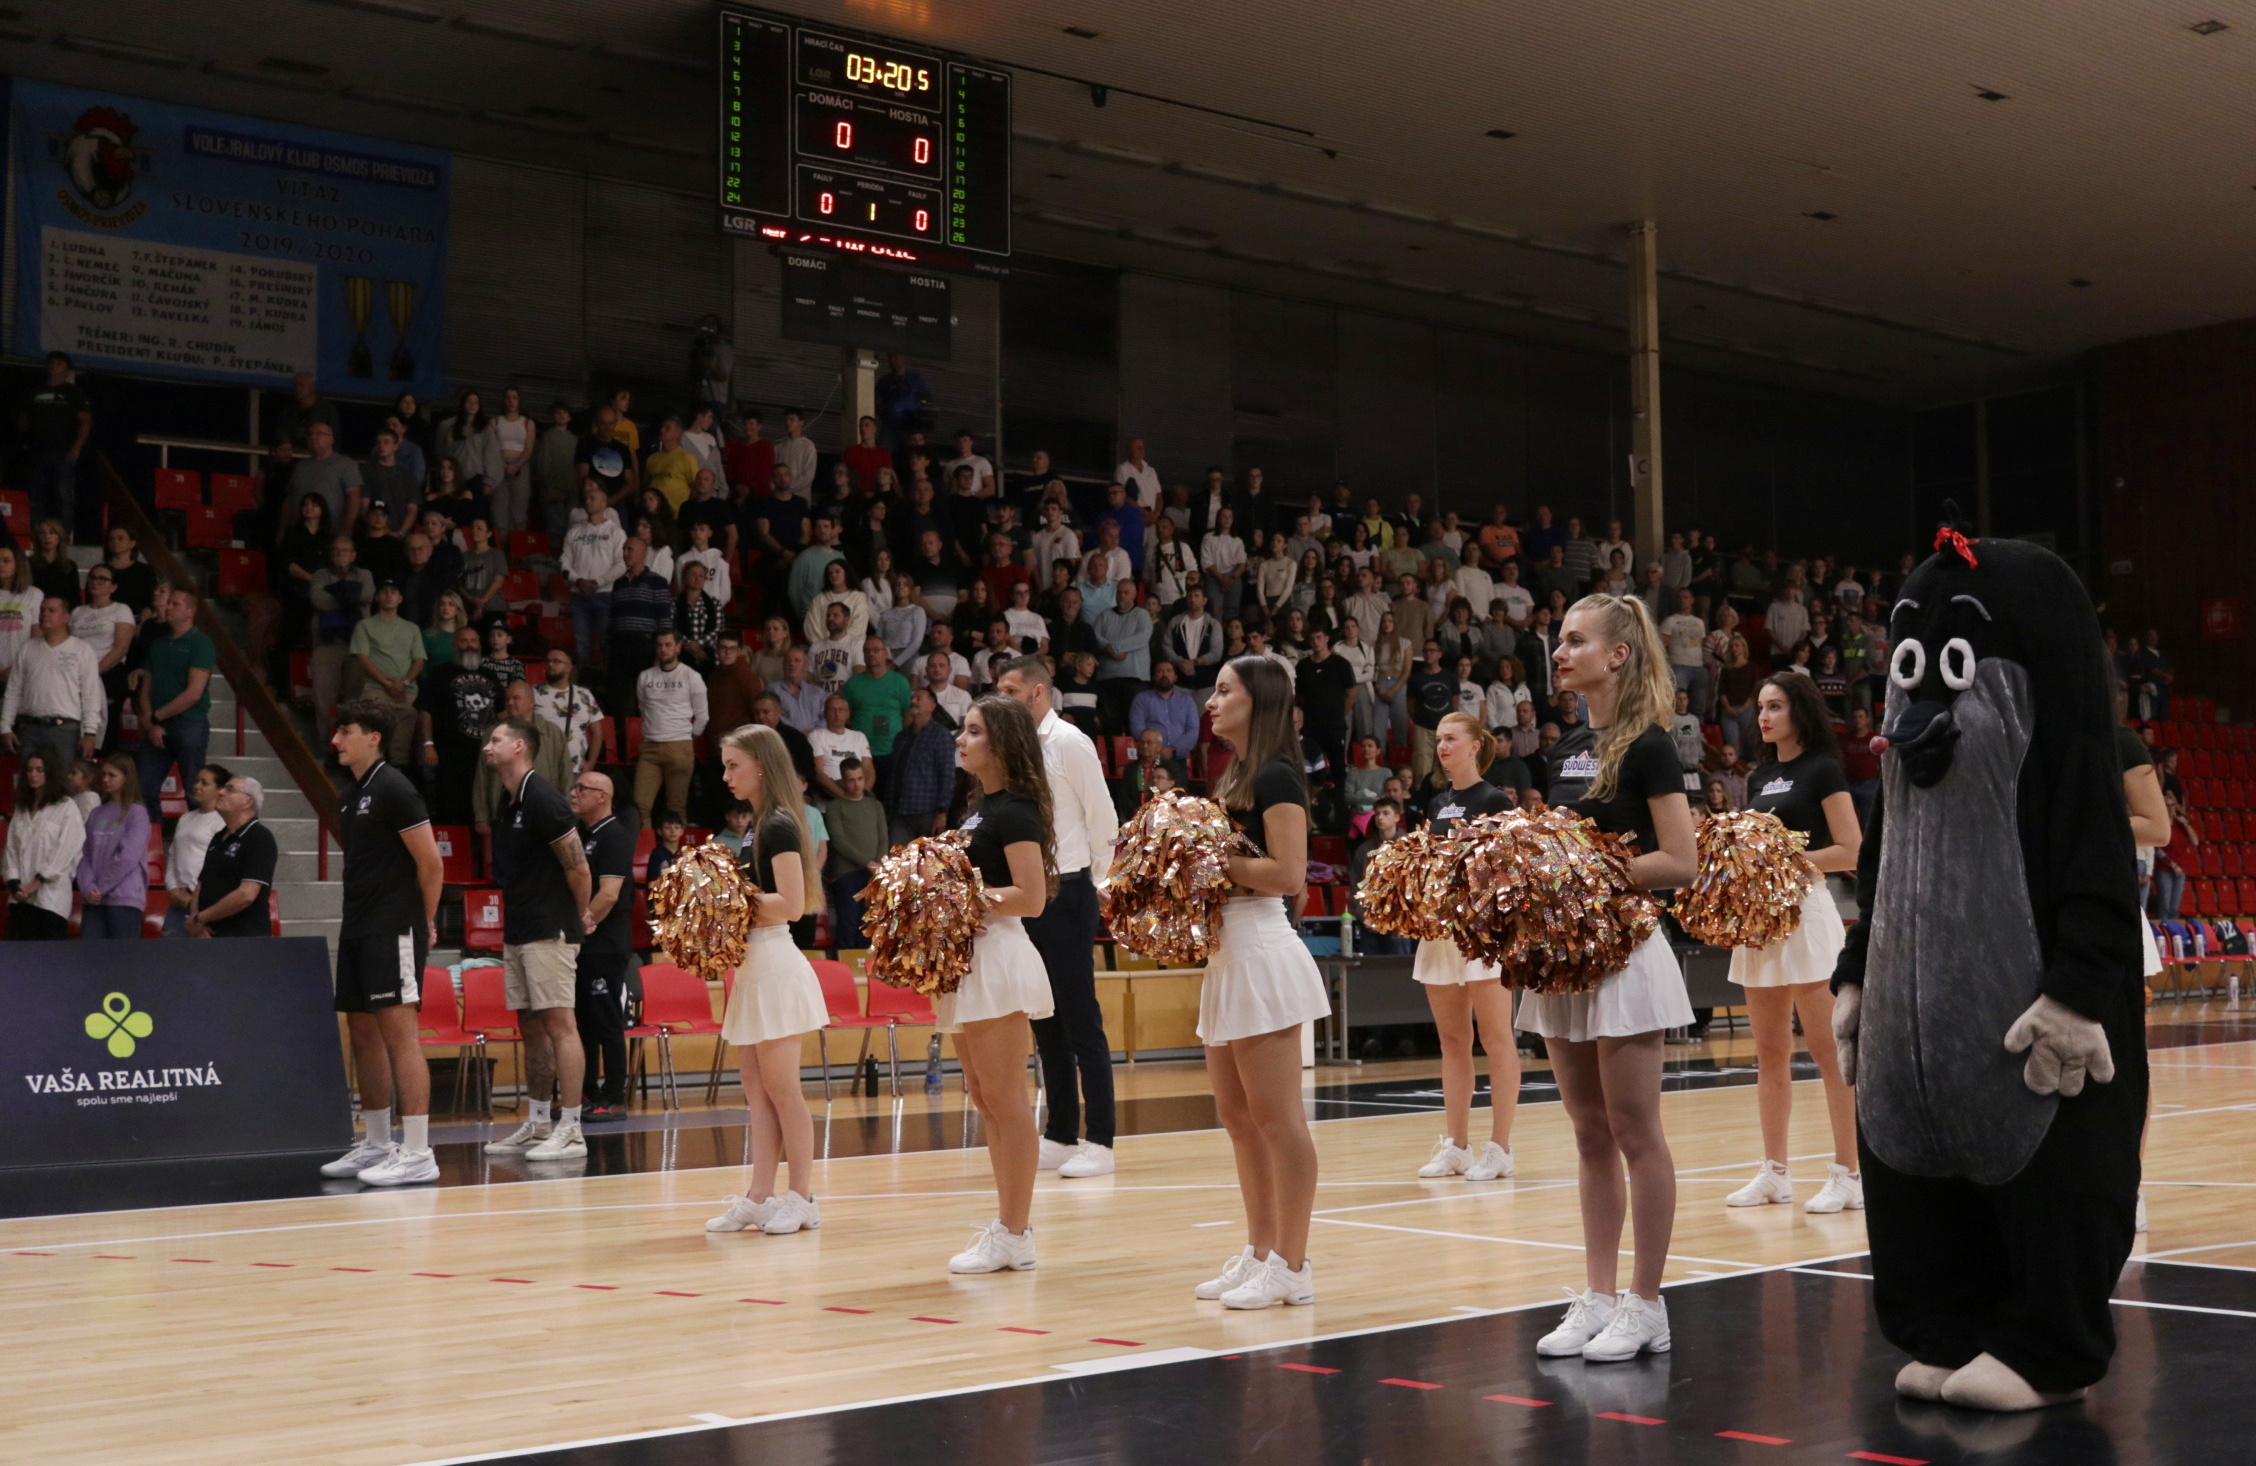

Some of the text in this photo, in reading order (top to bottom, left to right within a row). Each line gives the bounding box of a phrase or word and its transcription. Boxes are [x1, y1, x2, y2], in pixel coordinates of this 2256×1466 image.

[736, 26, 741, 36] 1
[733, 41, 741, 51] 3
[733, 56, 741, 66] 4
[733, 71, 741, 81] 6
[961, 76, 965, 85] 1
[733, 86, 741, 97] 7
[958, 90, 966, 100] 4
[809, 90, 854, 110] DOMÁCI
[733, 101, 741, 112] 8
[958, 104, 965, 114] 5
[730, 116, 741, 126] 10
[889, 108, 929, 126] HOSTIA
[958, 118, 965, 128] 6
[730, 131, 741, 141] 12
[836, 121, 851, 149] 0
[956, 133, 965, 142] 10
[730, 147, 741, 157] 13
[915, 138, 930, 165] 0
[956, 147, 965, 156] 11
[192, 132, 437, 186] VOLEJBALOVÝ KLUB OSMOS PRIEVIDZA
[730, 162, 741, 172] 17
[956, 161, 965, 171] 12
[727, 177, 740, 187] 22
[813, 172, 833, 182] FAULY
[956, 175, 966, 185] 17
[857, 180, 884, 192] PERIÓDA
[727, 192, 741, 203] 24
[908, 190, 928, 200] FAULY
[953, 189, 965, 199] 20
[820, 192, 834, 215] 0
[952, 203, 965, 213] 22
[870, 203, 876, 222] 1
[724, 214, 756, 231] LGR
[916, 210, 929, 232] 0
[952, 218, 965, 228] 23
[952, 232, 965, 243] 26
[77, 258, 121, 273] NEMEC
[788, 254, 827, 271] DOMÁCI
[910, 276, 946, 291] HOSTIA
[64, 297, 113, 313] PAVLOV
[267, 295, 308, 309] KUDRA
[151, 308, 209, 324] PAVELKA
[265, 308, 306, 322] KUDRA
[138, 333, 164, 347] ING.
[169, 337, 181, 348] R.
[186, 338, 237, 354] CHUDÍK
[77, 339, 151, 358] PREZIDENT
[156, 350, 204, 365] KLUBU:
[213, 356, 224, 367] P.
[1638, 459, 1647, 475] C
[814, 648, 849, 668] GOLDEN
[646, 679, 683, 689] GUESS
[437, 831, 449, 841] 30
[488, 894, 499, 905] 30
[2217, 919, 2237, 940] 12
[25, 1061, 222, 1094] VAŠA REALITNÁ
[76, 1091, 178, 1108] spolu sme najlepší
